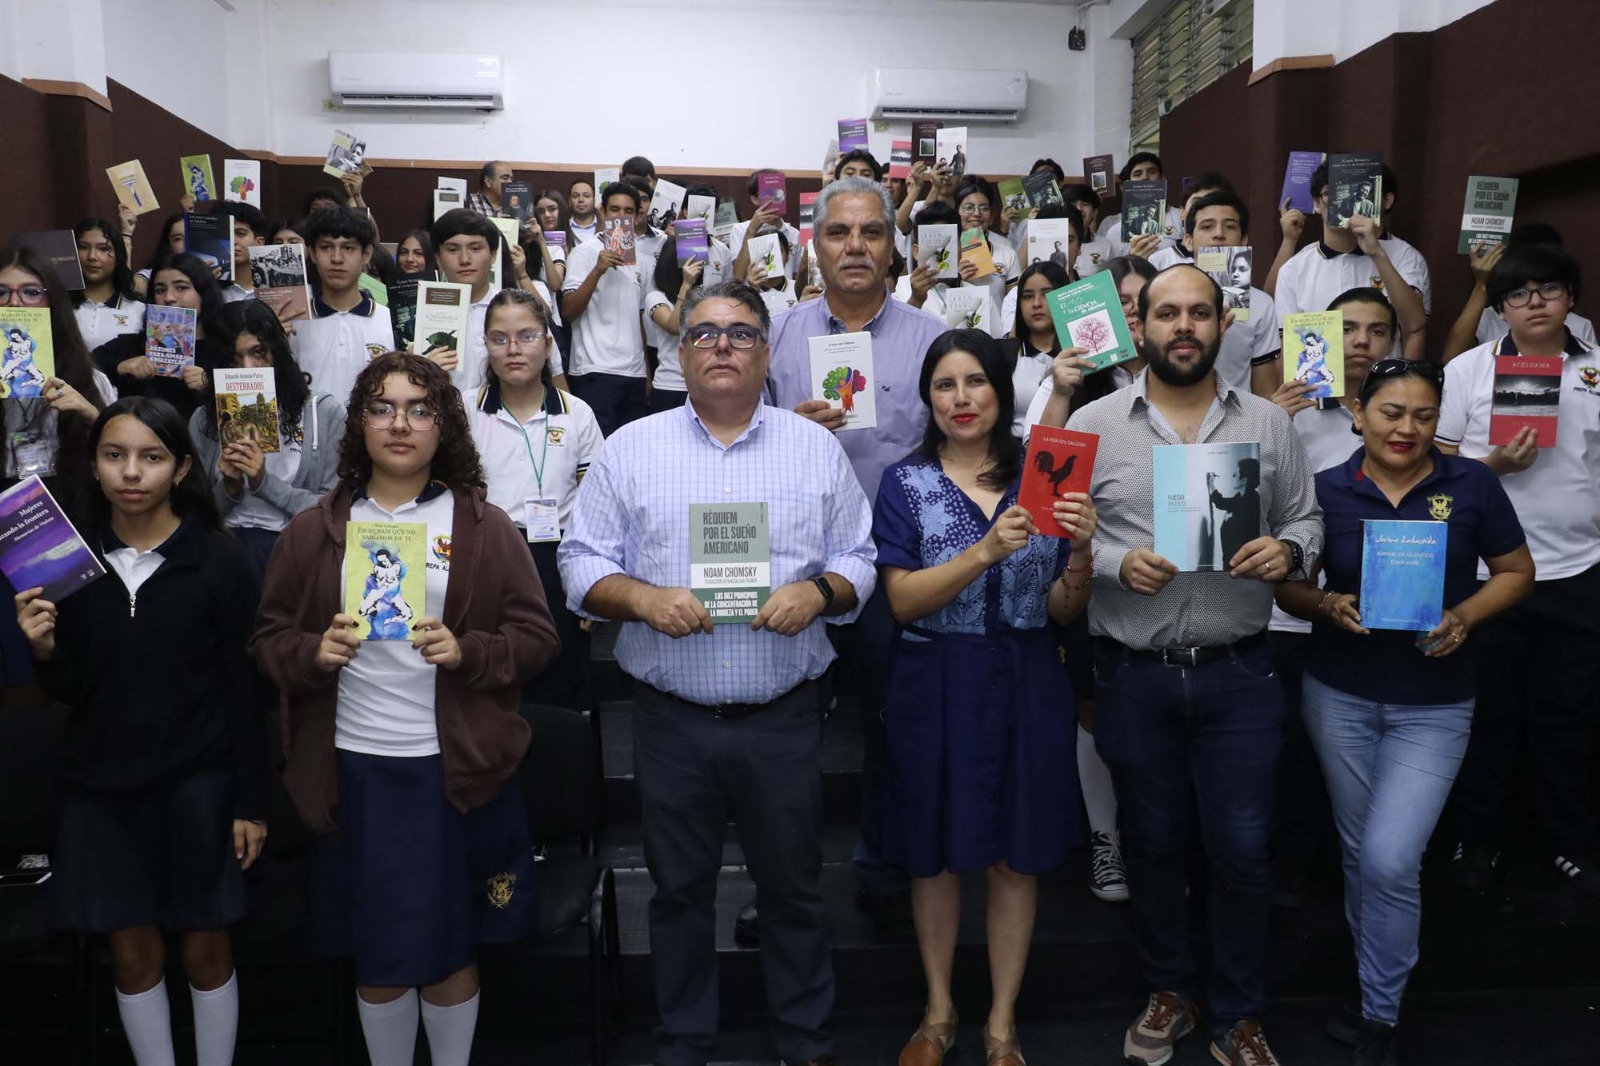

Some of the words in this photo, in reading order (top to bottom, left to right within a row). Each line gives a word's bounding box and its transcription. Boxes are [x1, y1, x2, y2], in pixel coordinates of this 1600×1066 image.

[226, 382, 264, 391] DESTERRADOS
[19, 501, 44, 517] Mujeres
[24, 509, 50, 525] frontera
[703, 509, 738, 525] RÉQUIEM
[703, 527, 719, 540] POR
[721, 526, 730, 539] EL
[731, 523, 757, 539] SUEÑO
[1375, 534, 1399, 544] Jaime
[1401, 535, 1437, 545] Labastida
[703, 541, 749, 555] AMERICANO
[425, 562, 440, 570] REPA
[703, 567, 723, 578] NOAM
[724, 566, 757, 577] CHOMSKY
[733, 591, 758, 599] PRINCIPIOS
[716, 600, 751, 608] CONCENTRACIÓN
[744, 608, 758, 616] PODER
